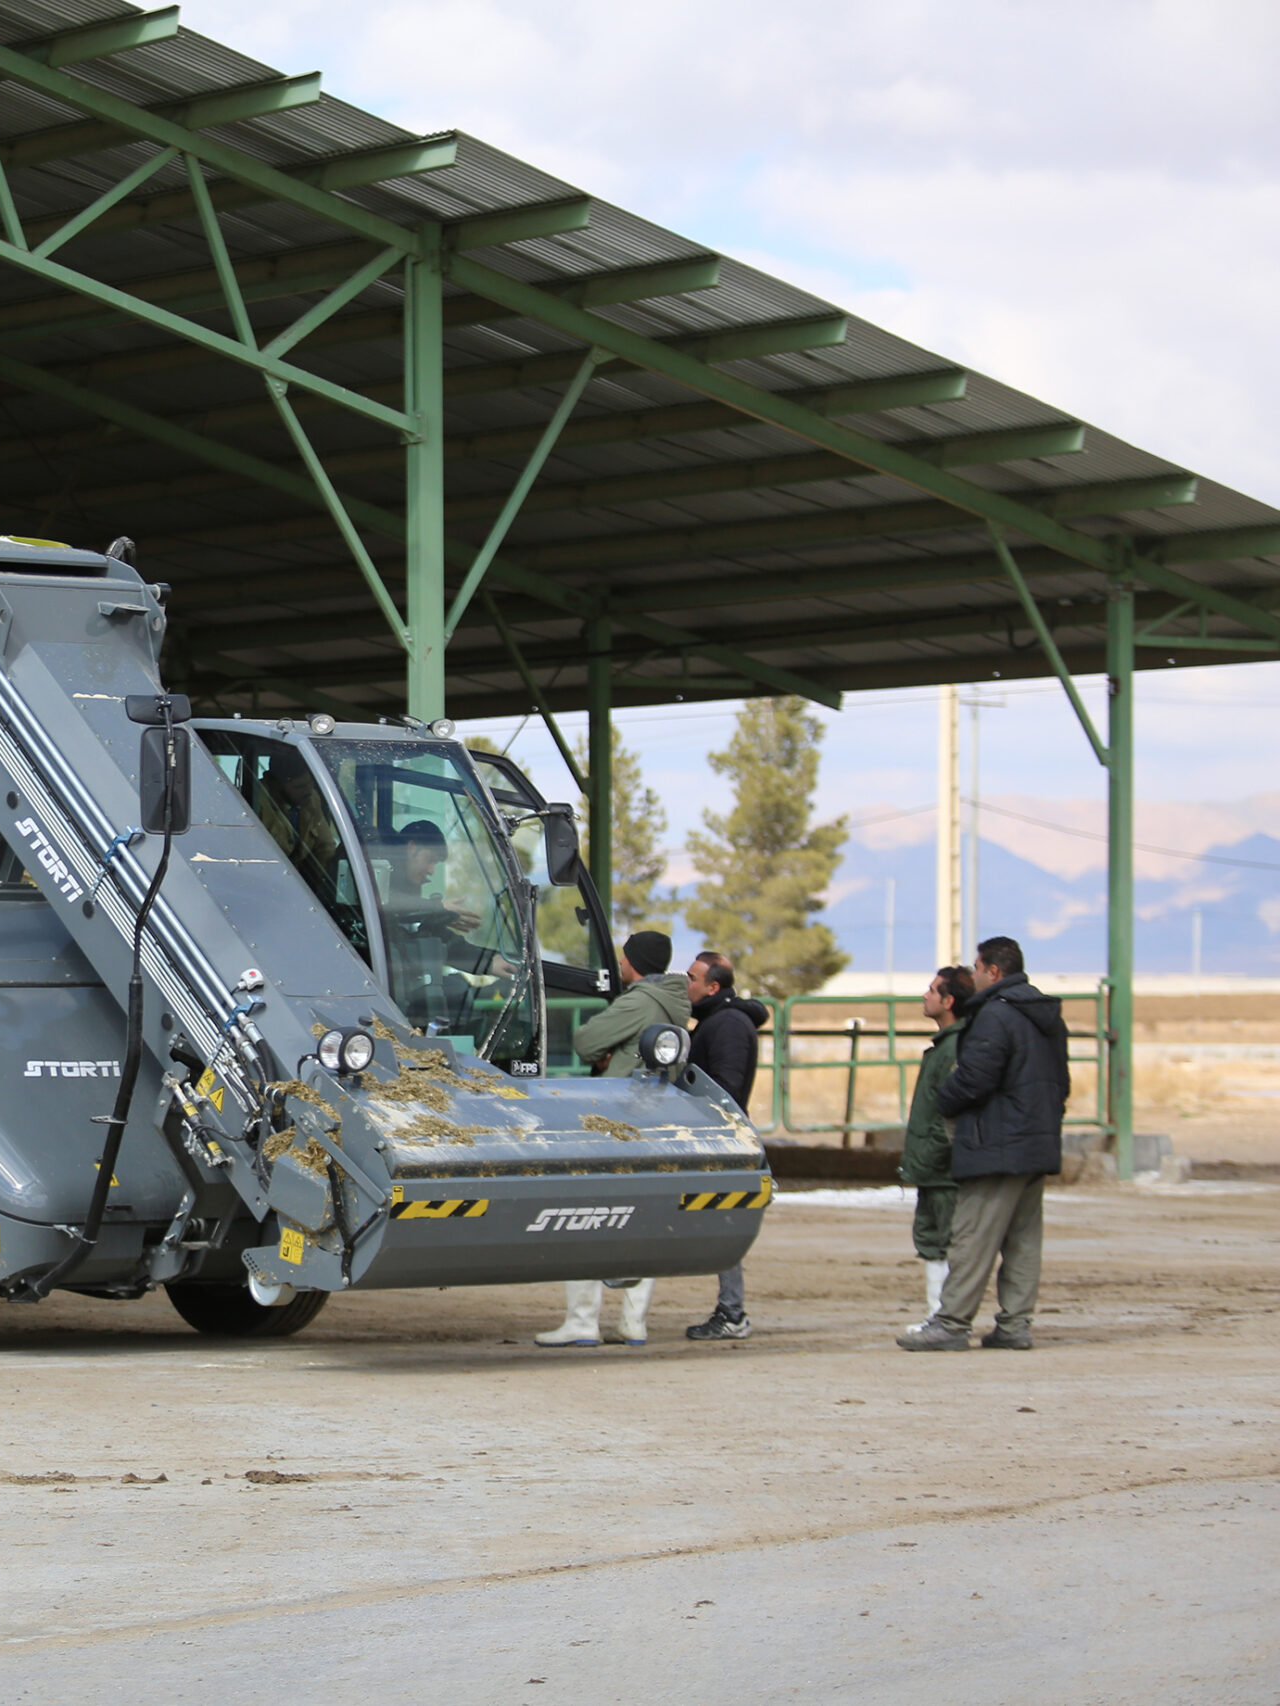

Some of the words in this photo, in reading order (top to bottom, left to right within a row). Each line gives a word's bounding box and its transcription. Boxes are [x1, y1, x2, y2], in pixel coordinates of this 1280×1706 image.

[14, 817, 84, 903] STORTI
[23, 1060, 121, 1077] STORTI
[526, 1206, 635, 1232] STORTI
